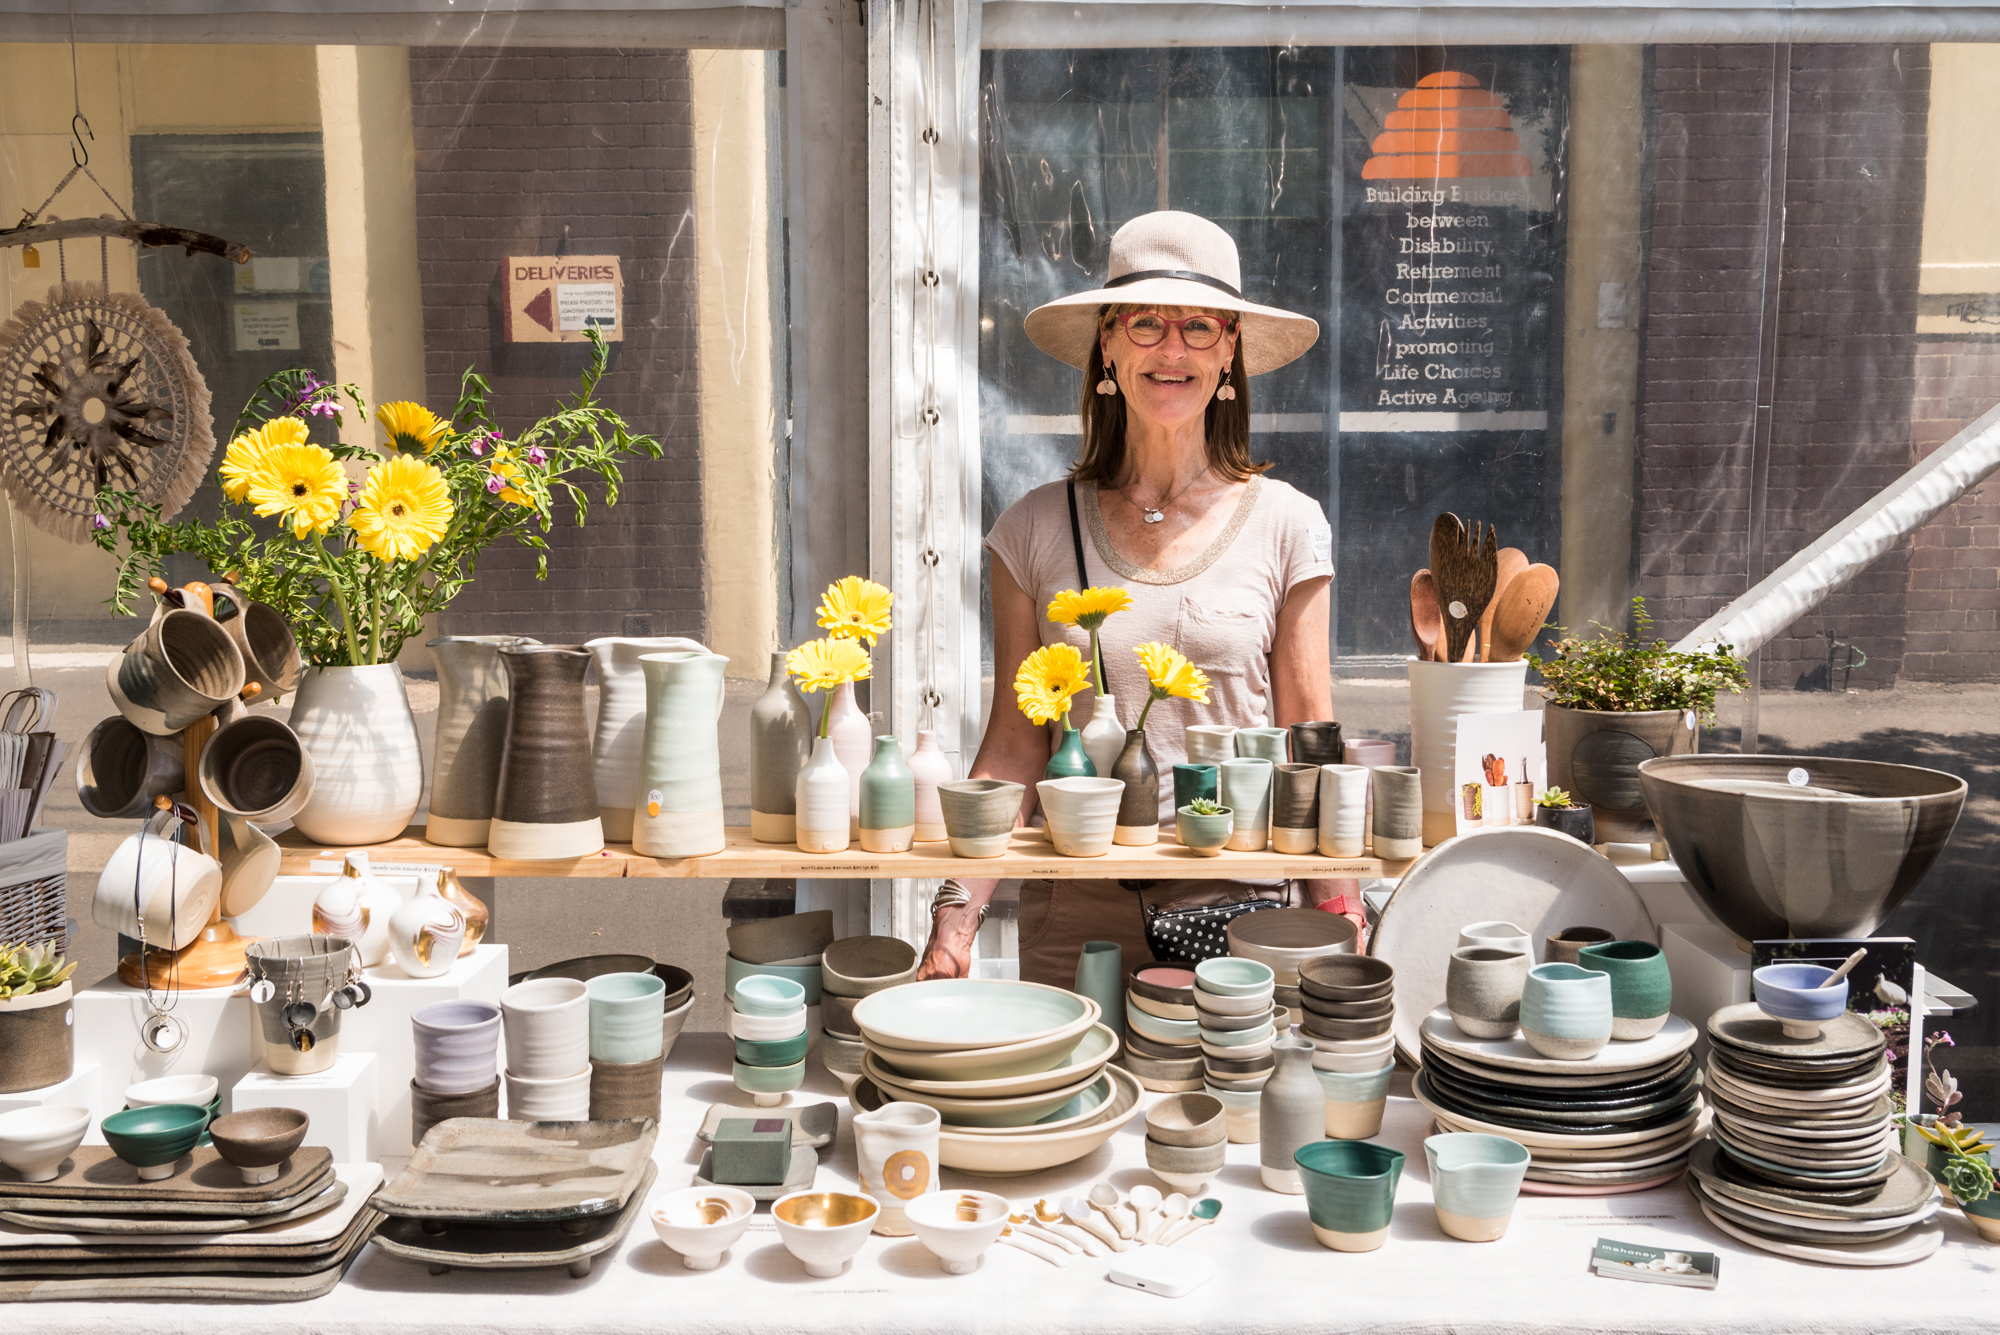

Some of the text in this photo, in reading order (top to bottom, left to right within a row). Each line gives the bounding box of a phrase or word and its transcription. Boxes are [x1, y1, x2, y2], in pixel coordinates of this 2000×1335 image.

[1366, 186, 1446, 206] Building
[1406, 212, 1491, 228] between
[515, 266, 615, 280] DELIVERIES
[1396, 263, 1501, 280] Retirement
[1386, 288, 1503, 304] Commercial
[1398, 314, 1487, 330] Activities
[1395, 339, 1494, 359] promoting
[1383, 363, 1502, 380] Life Choices
[1378, 388, 1513, 408] Active Ageing
[1602, 1245, 1657, 1259] mahoney
